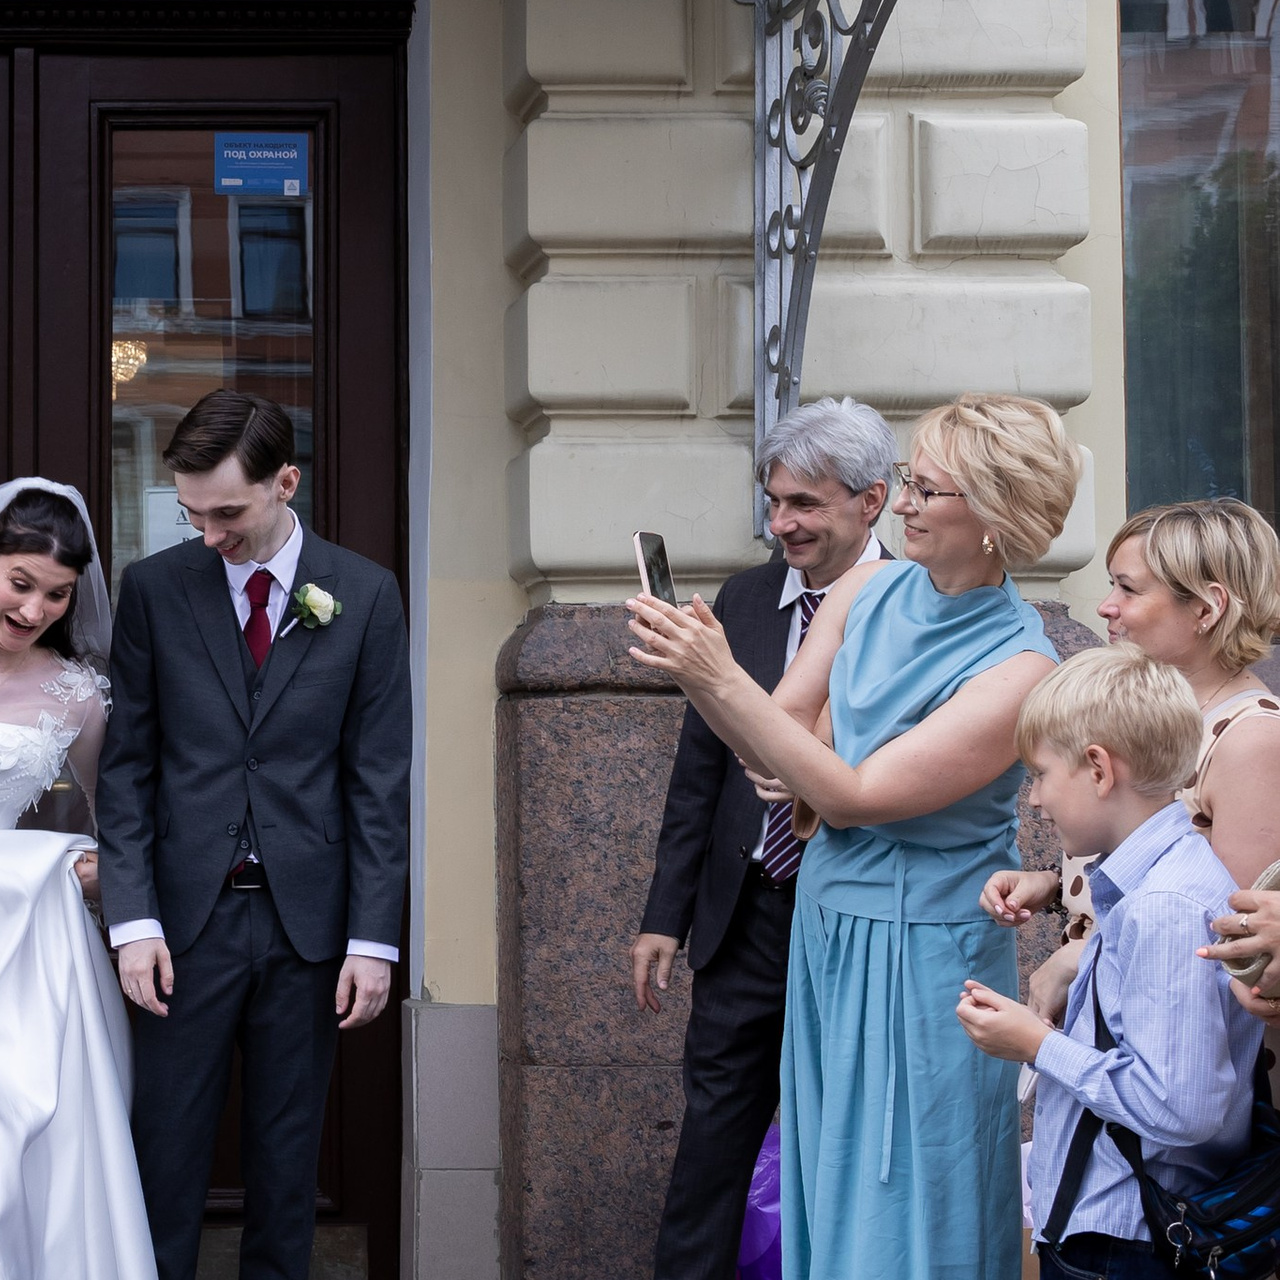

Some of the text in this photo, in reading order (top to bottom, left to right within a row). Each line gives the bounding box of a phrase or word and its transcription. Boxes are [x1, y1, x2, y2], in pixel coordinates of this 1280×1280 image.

[253, 142, 298, 150] НАХОДИТСЯ
[223, 149, 298, 160] ПОД ОХРАНОЙ
